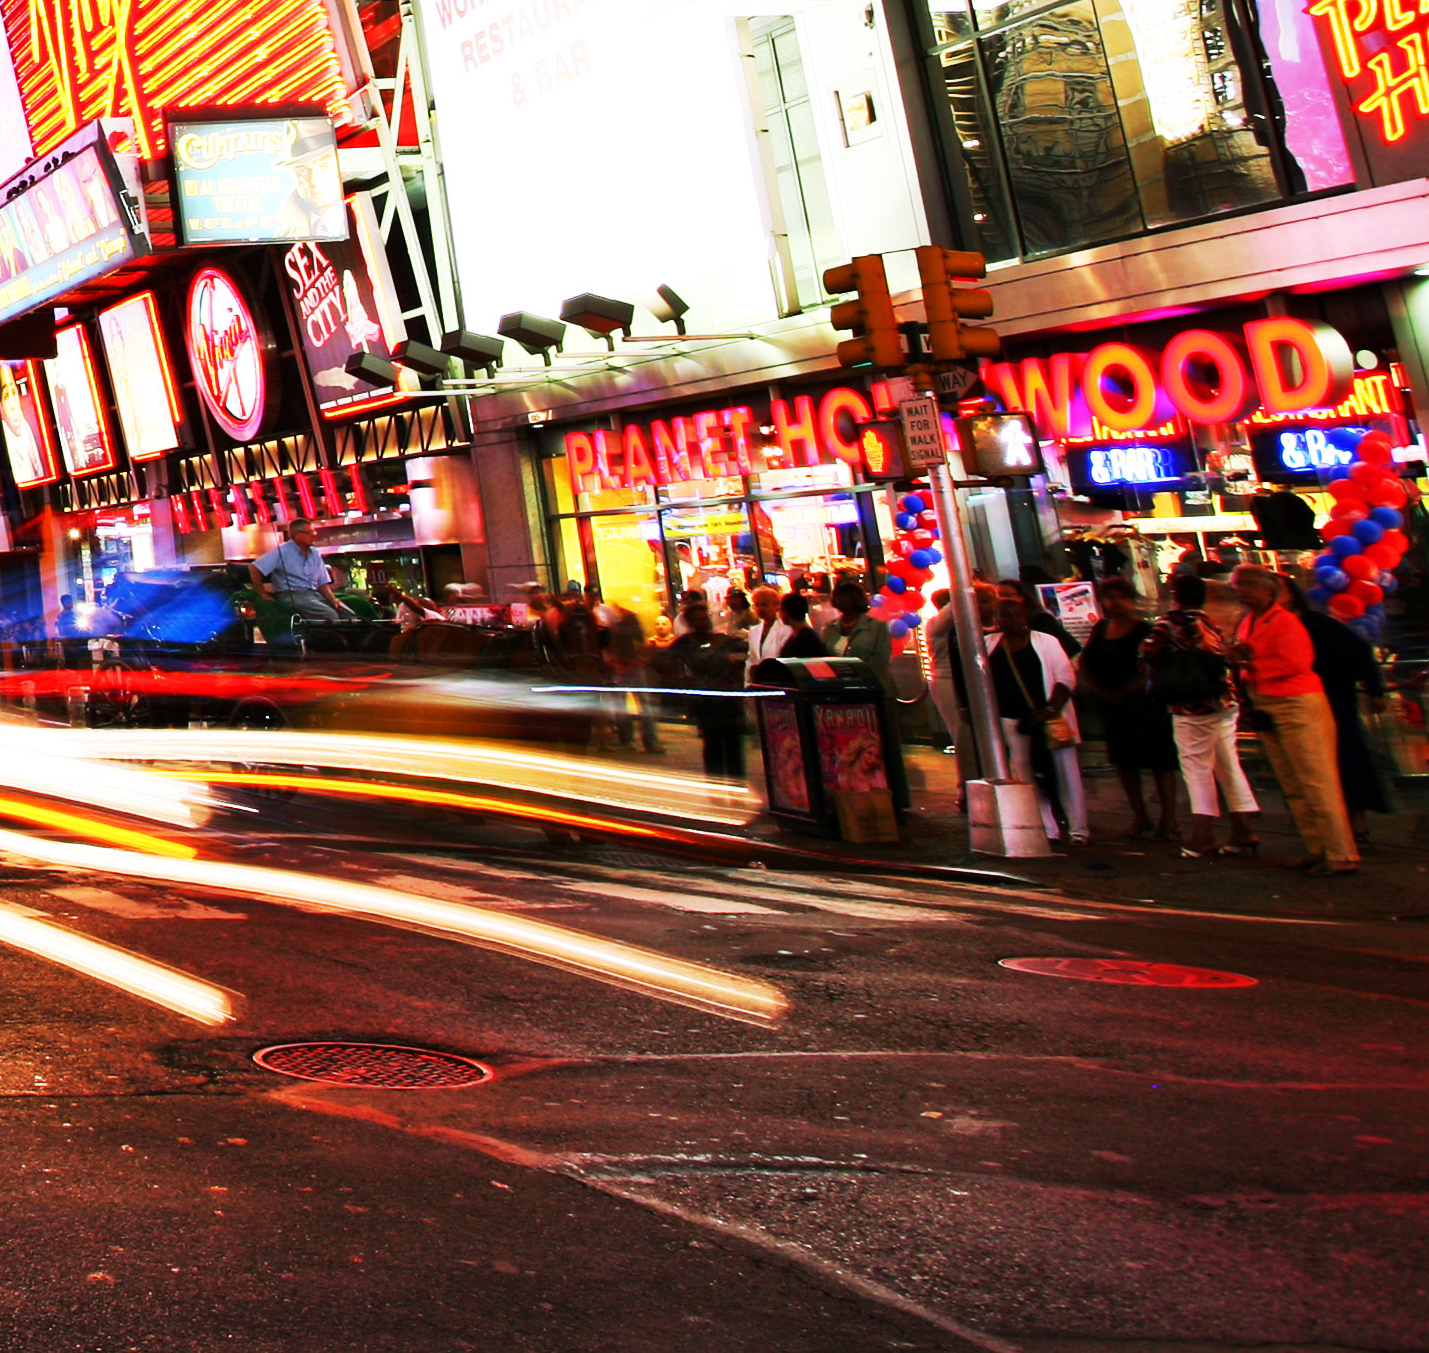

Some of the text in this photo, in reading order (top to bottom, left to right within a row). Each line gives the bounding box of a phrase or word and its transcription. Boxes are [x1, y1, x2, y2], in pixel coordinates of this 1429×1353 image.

[284, 240, 329, 299] SEX
[300, 266, 338, 320] AND THE
[304, 293, 350, 349] CITY
[939, 371, 968, 391] WAY
[906, 404, 929, 418] WAIT
[910, 419, 930, 432] FOR
[910, 432, 938, 446] WALK
[564, 404, 753, 495] PLANET
[910, 448, 942, 462] SIGNAL
